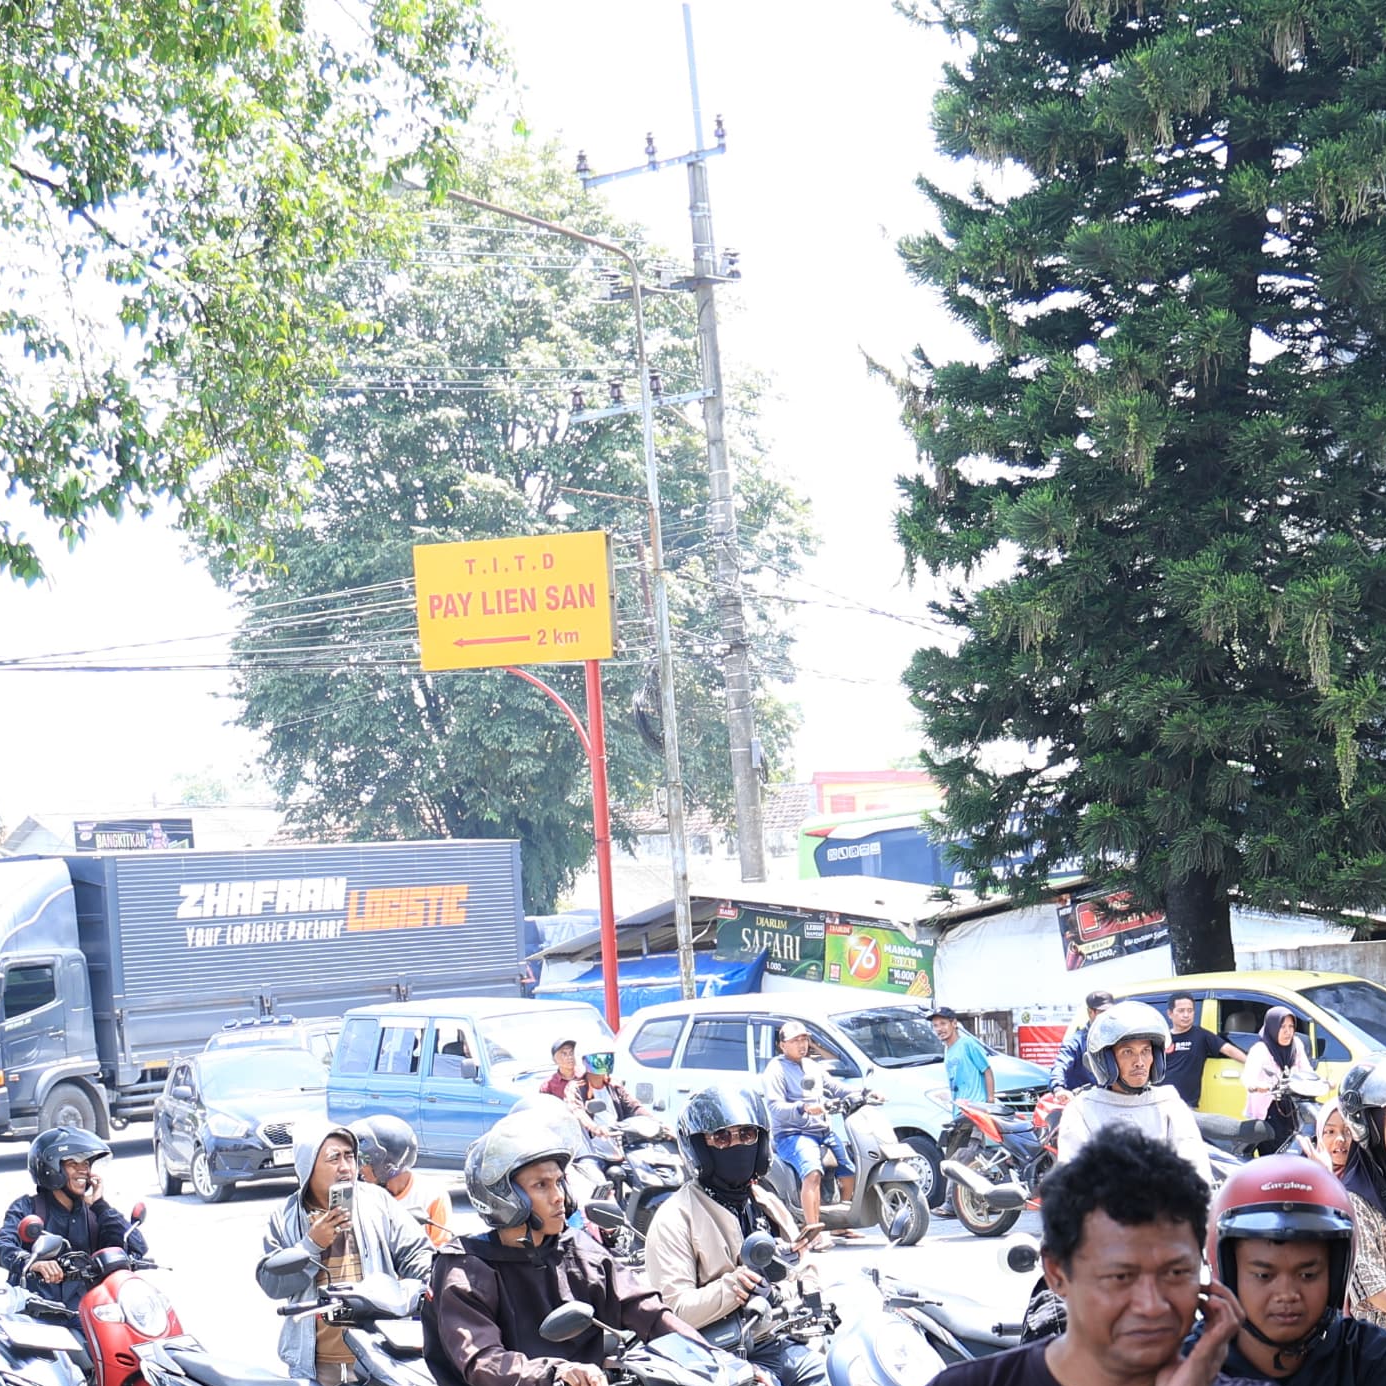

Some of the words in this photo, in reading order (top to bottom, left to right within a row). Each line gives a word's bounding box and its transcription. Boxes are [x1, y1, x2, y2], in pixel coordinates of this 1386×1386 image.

[429, 591, 473, 619] PAY
[482, 587, 537, 616] LIEN
[546, 583, 596, 610] SAN
[537, 629, 547, 646] 2
[553, 628, 580, 645] km
[176, 877, 347, 919] ZHAFRAN
[346, 884, 469, 932] LOGISTIC
[185, 924, 223, 948] Your
[287, 919, 344, 941] Partner
[755, 916, 788, 930] DJARUM
[740, 927, 801, 961] SAFARI
[850, 938, 877, 976] 76
[883, 943, 923, 958] MANGGA
